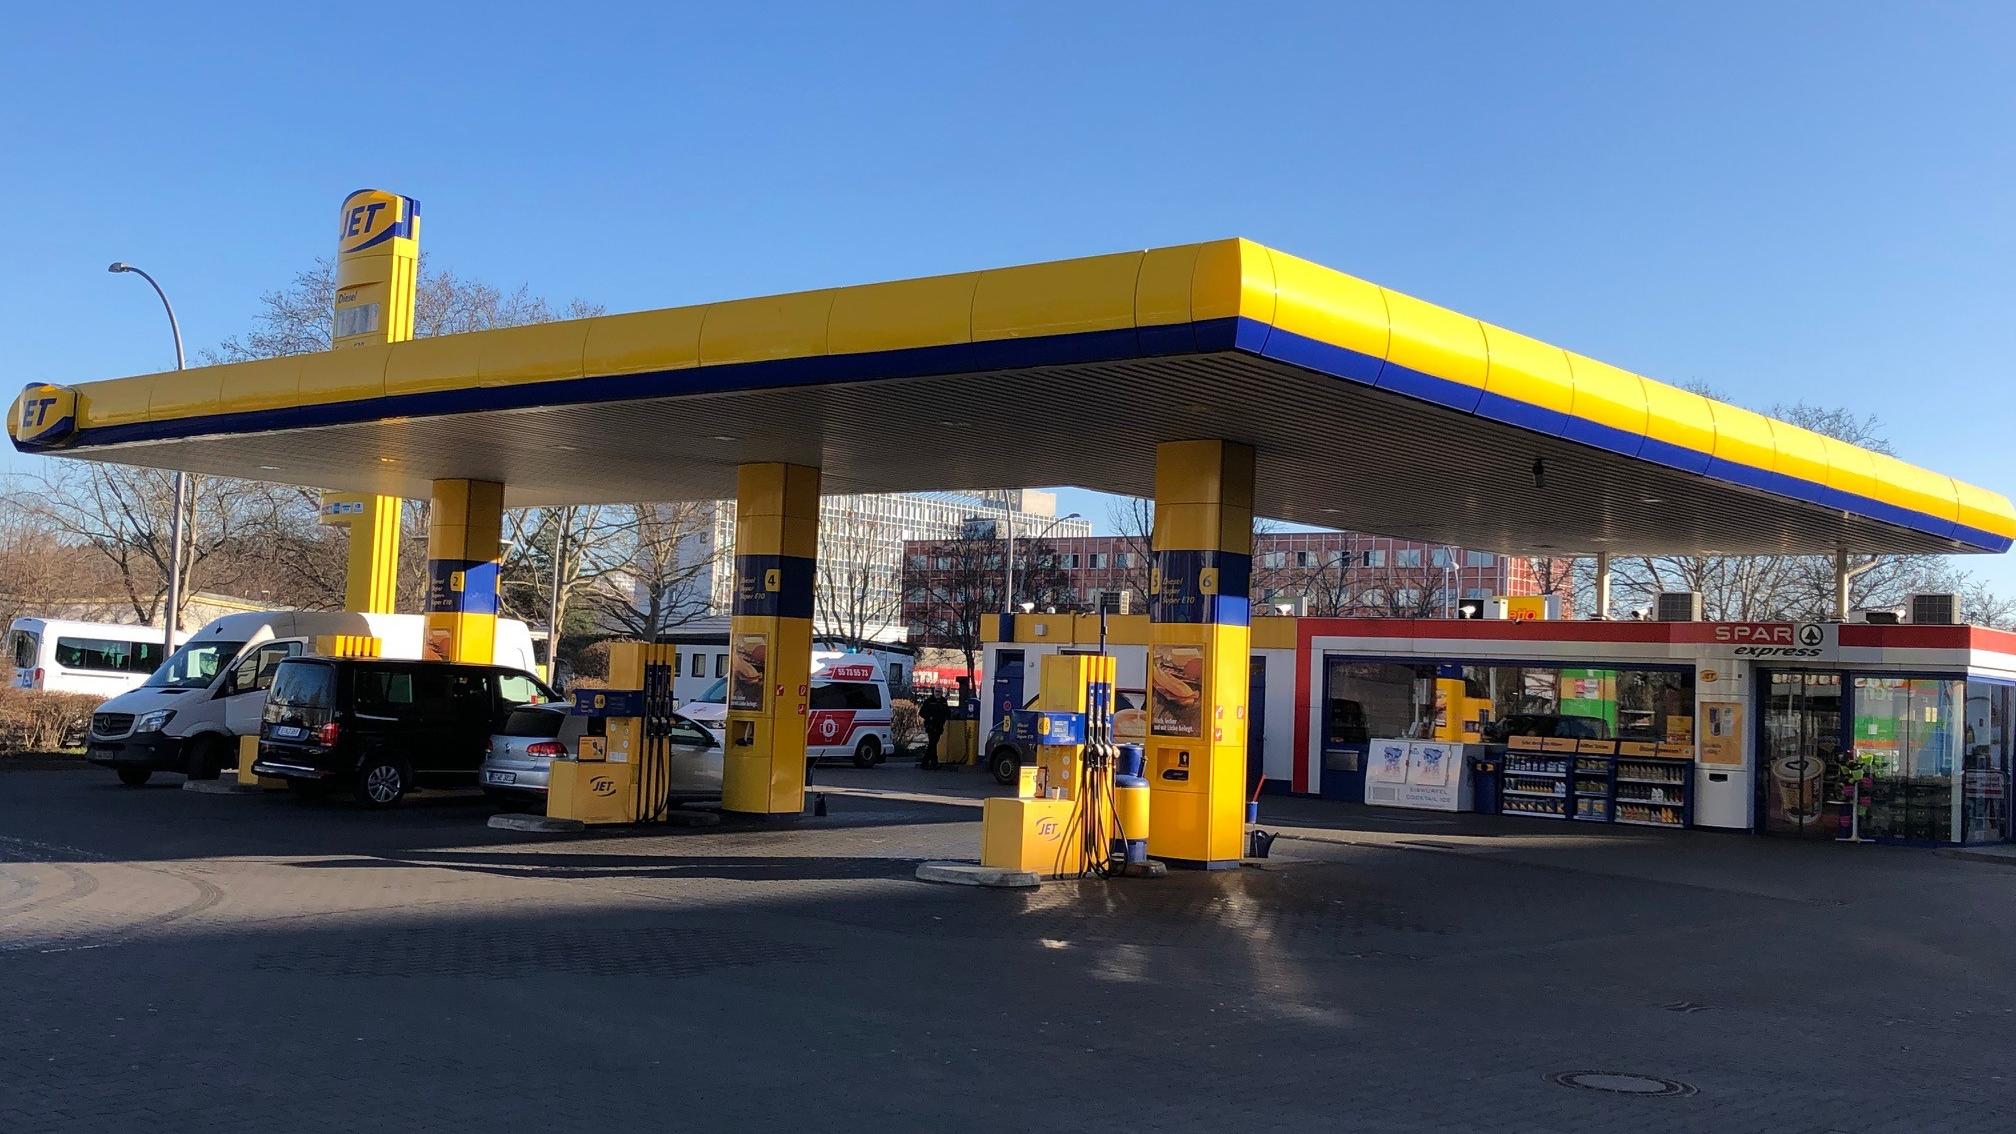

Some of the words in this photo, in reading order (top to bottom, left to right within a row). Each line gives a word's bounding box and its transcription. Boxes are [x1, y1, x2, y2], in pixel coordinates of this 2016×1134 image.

[340, 202, 386, 240] JET
[338, 291, 358, 303] Diesel
[22, 397, 58, 428] ET
[453, 577, 459, 586] 2
[768, 575, 776, 586] 4
[1163, 577, 1183, 585] Diesel
[1203, 575, 1212, 587] 6
[754, 592, 766, 600] E10
[1163, 597, 1180, 606] Super
[1181, 596, 1195, 604] E10
[1509, 608, 1537, 620] etto
[1715, 626, 1792, 641] SPAR
[1734, 646, 1823, 657] express
[592, 781, 614, 792] JET
[1038, 823, 1059, 835] JET
